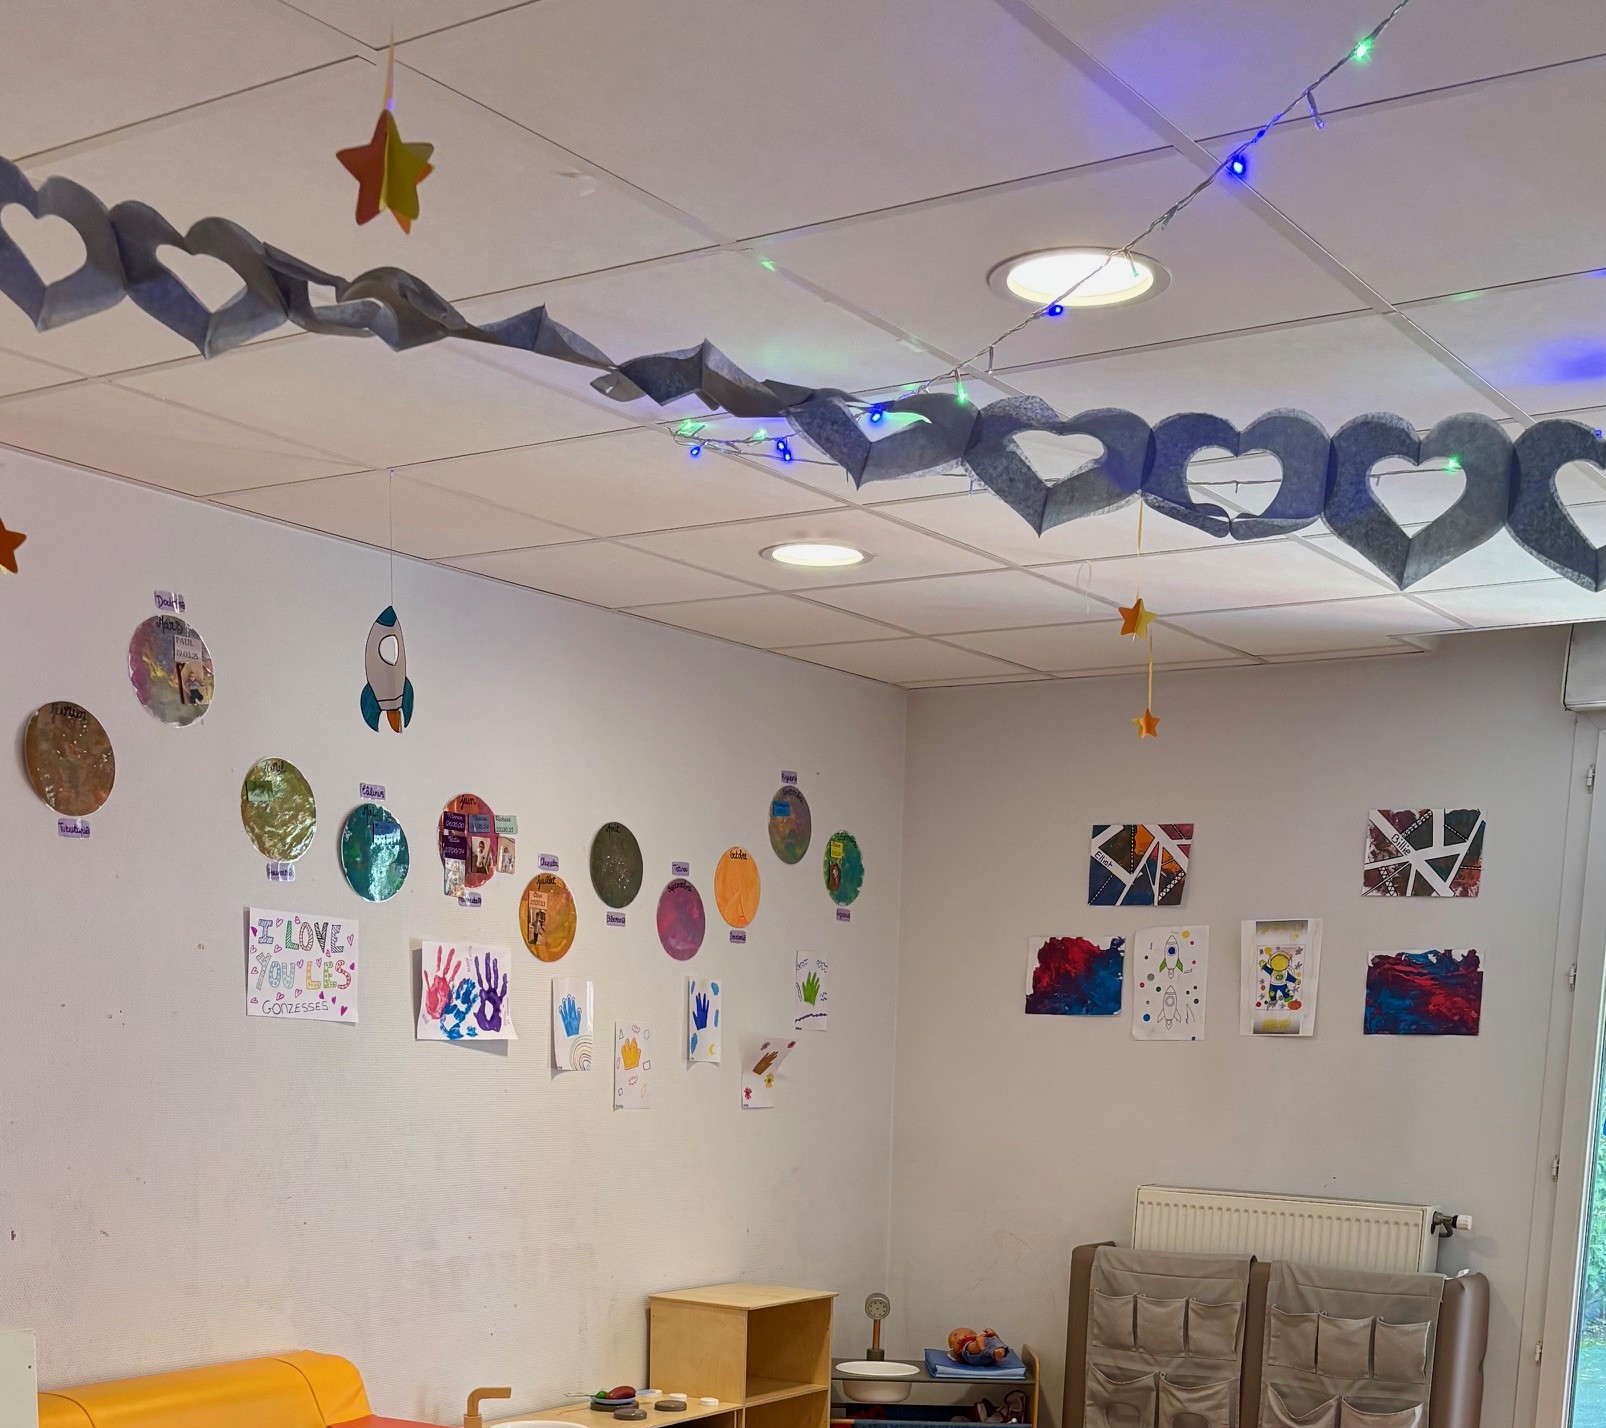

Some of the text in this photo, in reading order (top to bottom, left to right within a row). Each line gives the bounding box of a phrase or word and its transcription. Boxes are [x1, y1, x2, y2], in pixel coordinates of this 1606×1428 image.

[175, 636, 194, 647] PAUL
[1391, 833, 1411, 856] Billie
[258, 918, 344, 953] I LOVE
[256, 952, 352, 990] YOU LES
